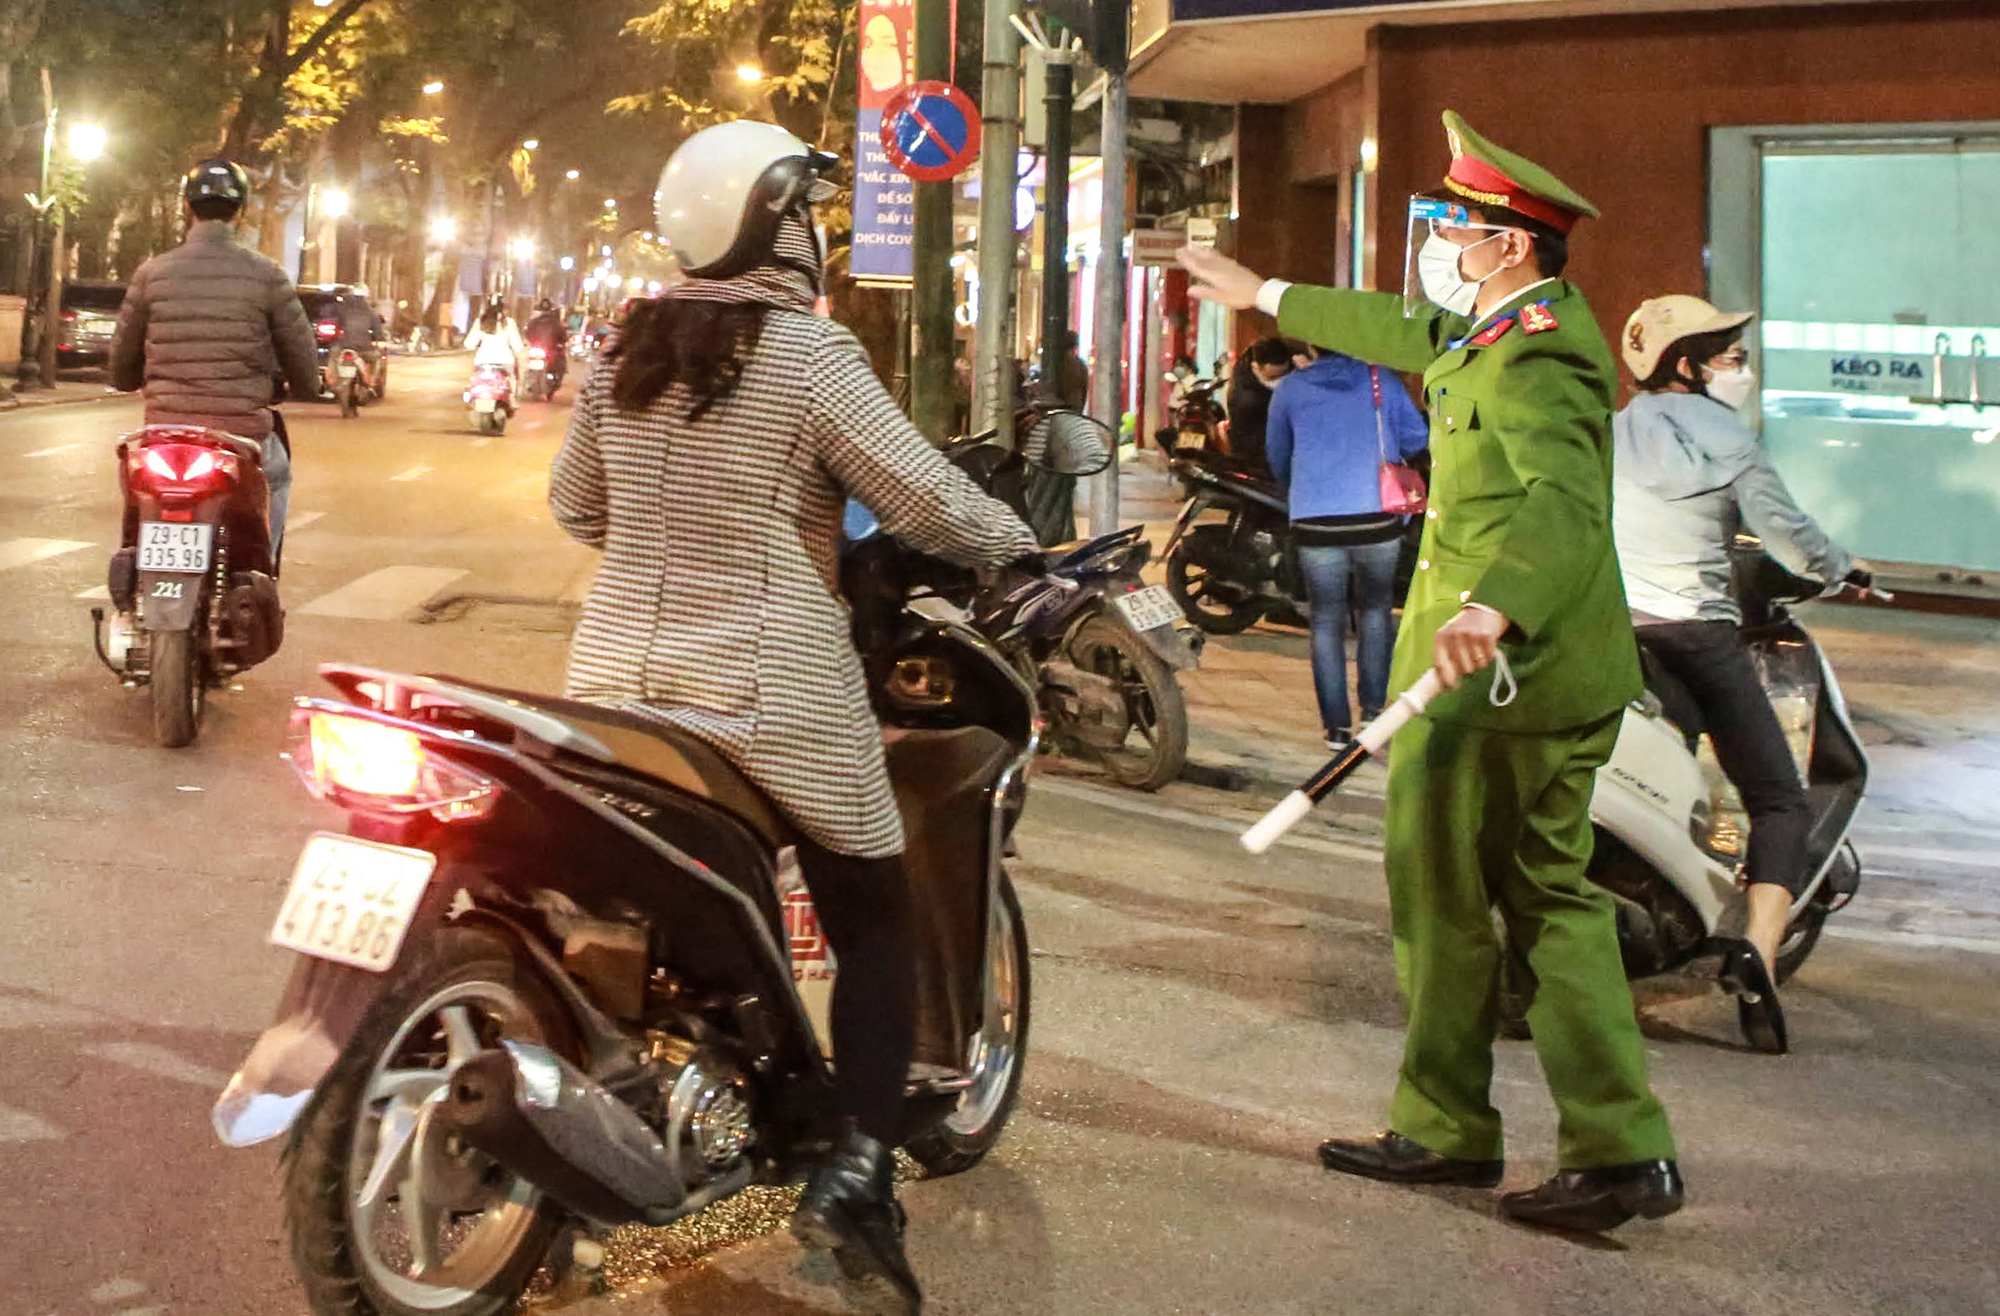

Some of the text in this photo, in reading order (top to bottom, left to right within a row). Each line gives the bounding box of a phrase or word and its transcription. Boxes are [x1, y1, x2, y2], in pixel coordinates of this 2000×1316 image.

[1889, 359, 1923, 378] RA
[151, 526, 199, 545] 29-C1
[143, 547, 203, 568] 335.96
